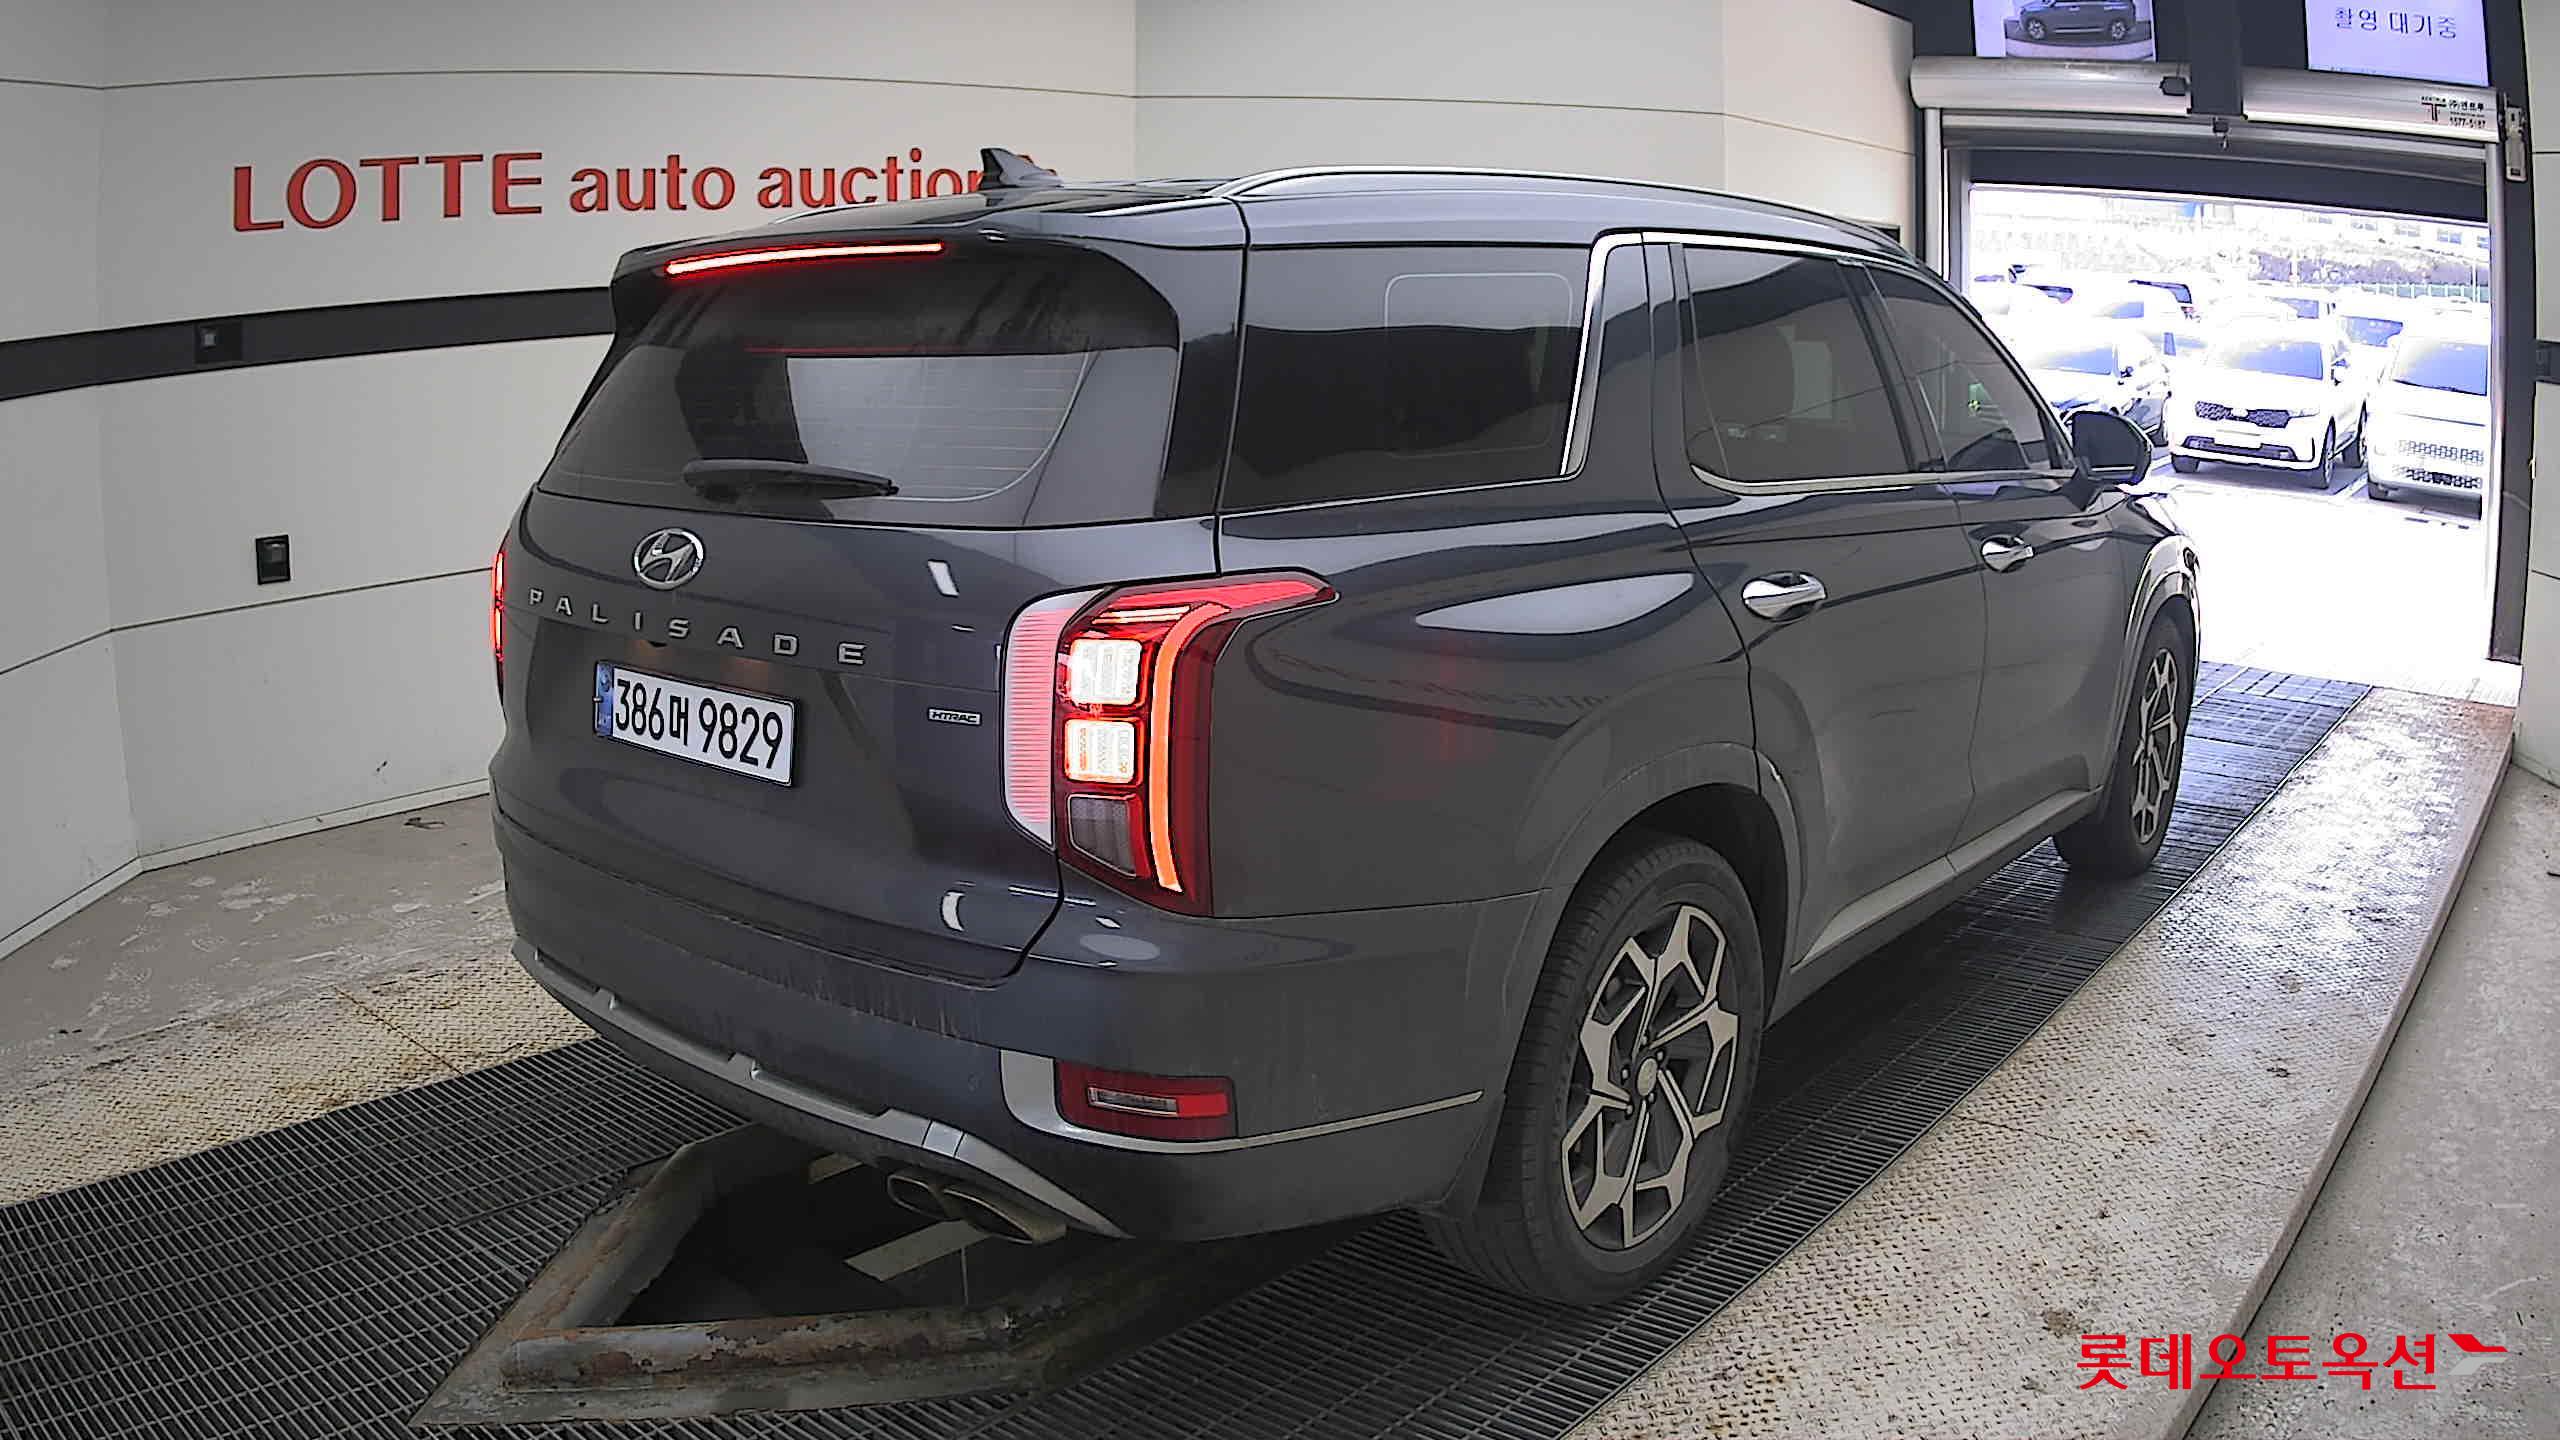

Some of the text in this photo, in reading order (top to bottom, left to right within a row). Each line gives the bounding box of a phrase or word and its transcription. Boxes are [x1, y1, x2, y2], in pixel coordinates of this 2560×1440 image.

[2388, 11, 2457, 40] 대기중
[233, 152, 543, 232] LOTTE
[569, 154, 736, 212] auto
[528, 588, 867, 665] PALISADE
[615, 678, 784, 769] 386머 9829
[930, 710, 979, 723] HTRAC
